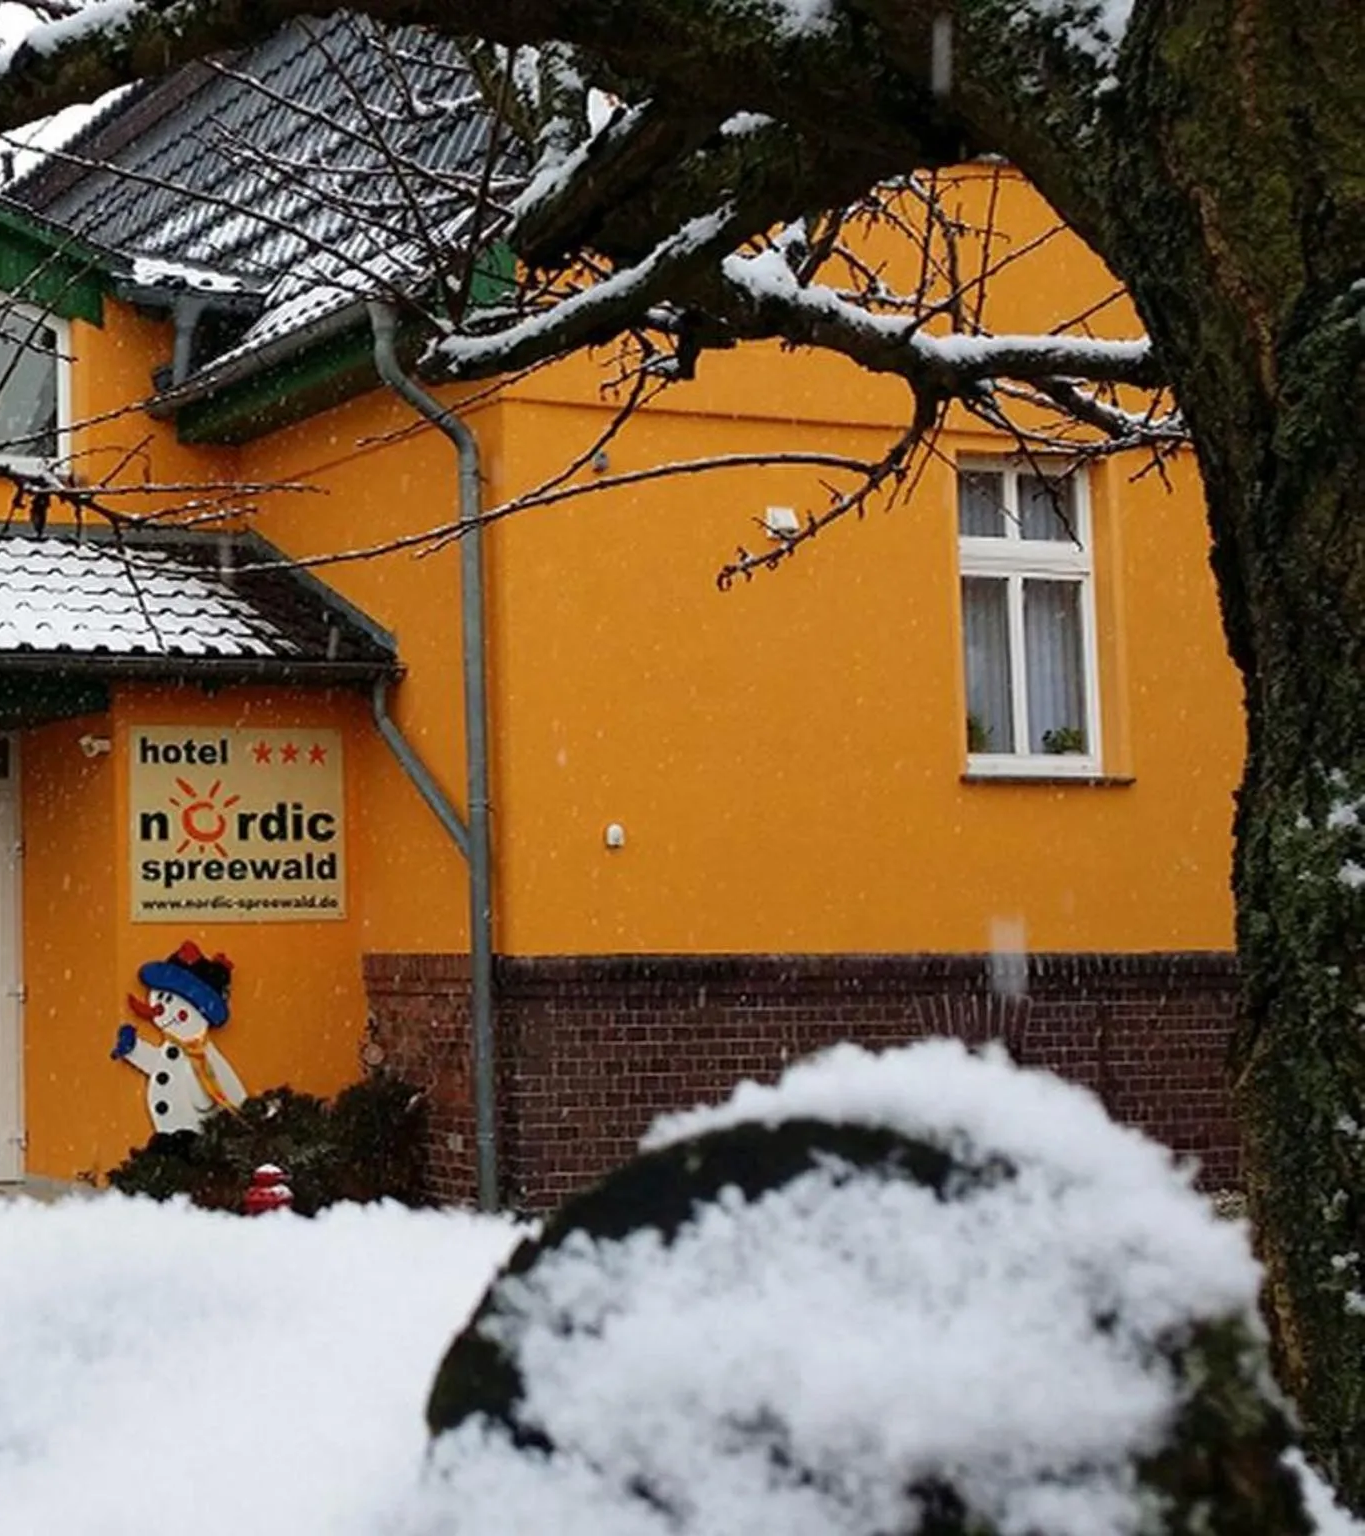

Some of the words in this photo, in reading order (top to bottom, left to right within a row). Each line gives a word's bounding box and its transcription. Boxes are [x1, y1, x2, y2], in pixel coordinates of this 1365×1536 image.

[140, 737, 228, 764] hotel
[140, 801, 335, 842] nordic
[141, 853, 337, 888] spreewald
